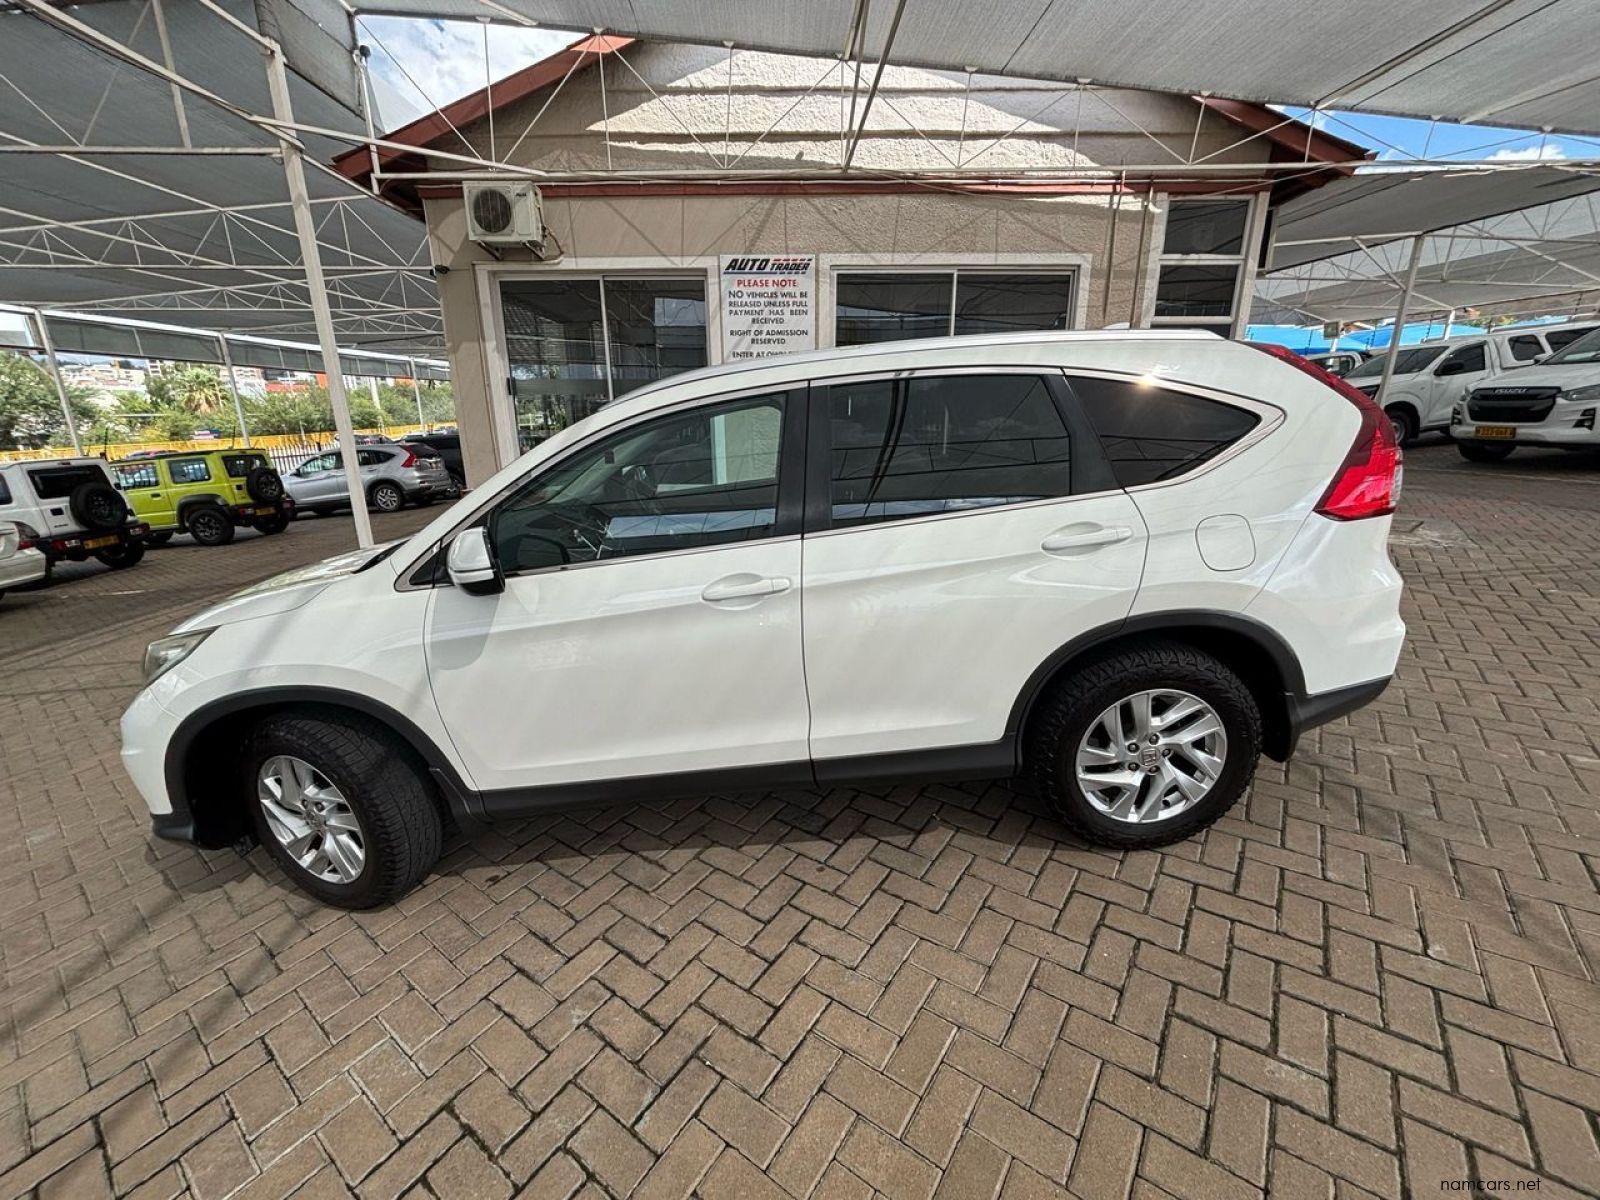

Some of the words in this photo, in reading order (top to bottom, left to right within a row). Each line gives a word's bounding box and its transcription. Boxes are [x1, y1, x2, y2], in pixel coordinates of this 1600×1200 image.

[725, 258, 770, 271] AUTO
[770, 262, 810, 271] TRADER
[737, 279, 769, 287] PLEASE
[728, 290, 745, 298] NO
[730, 329, 752, 337] RIGHT
